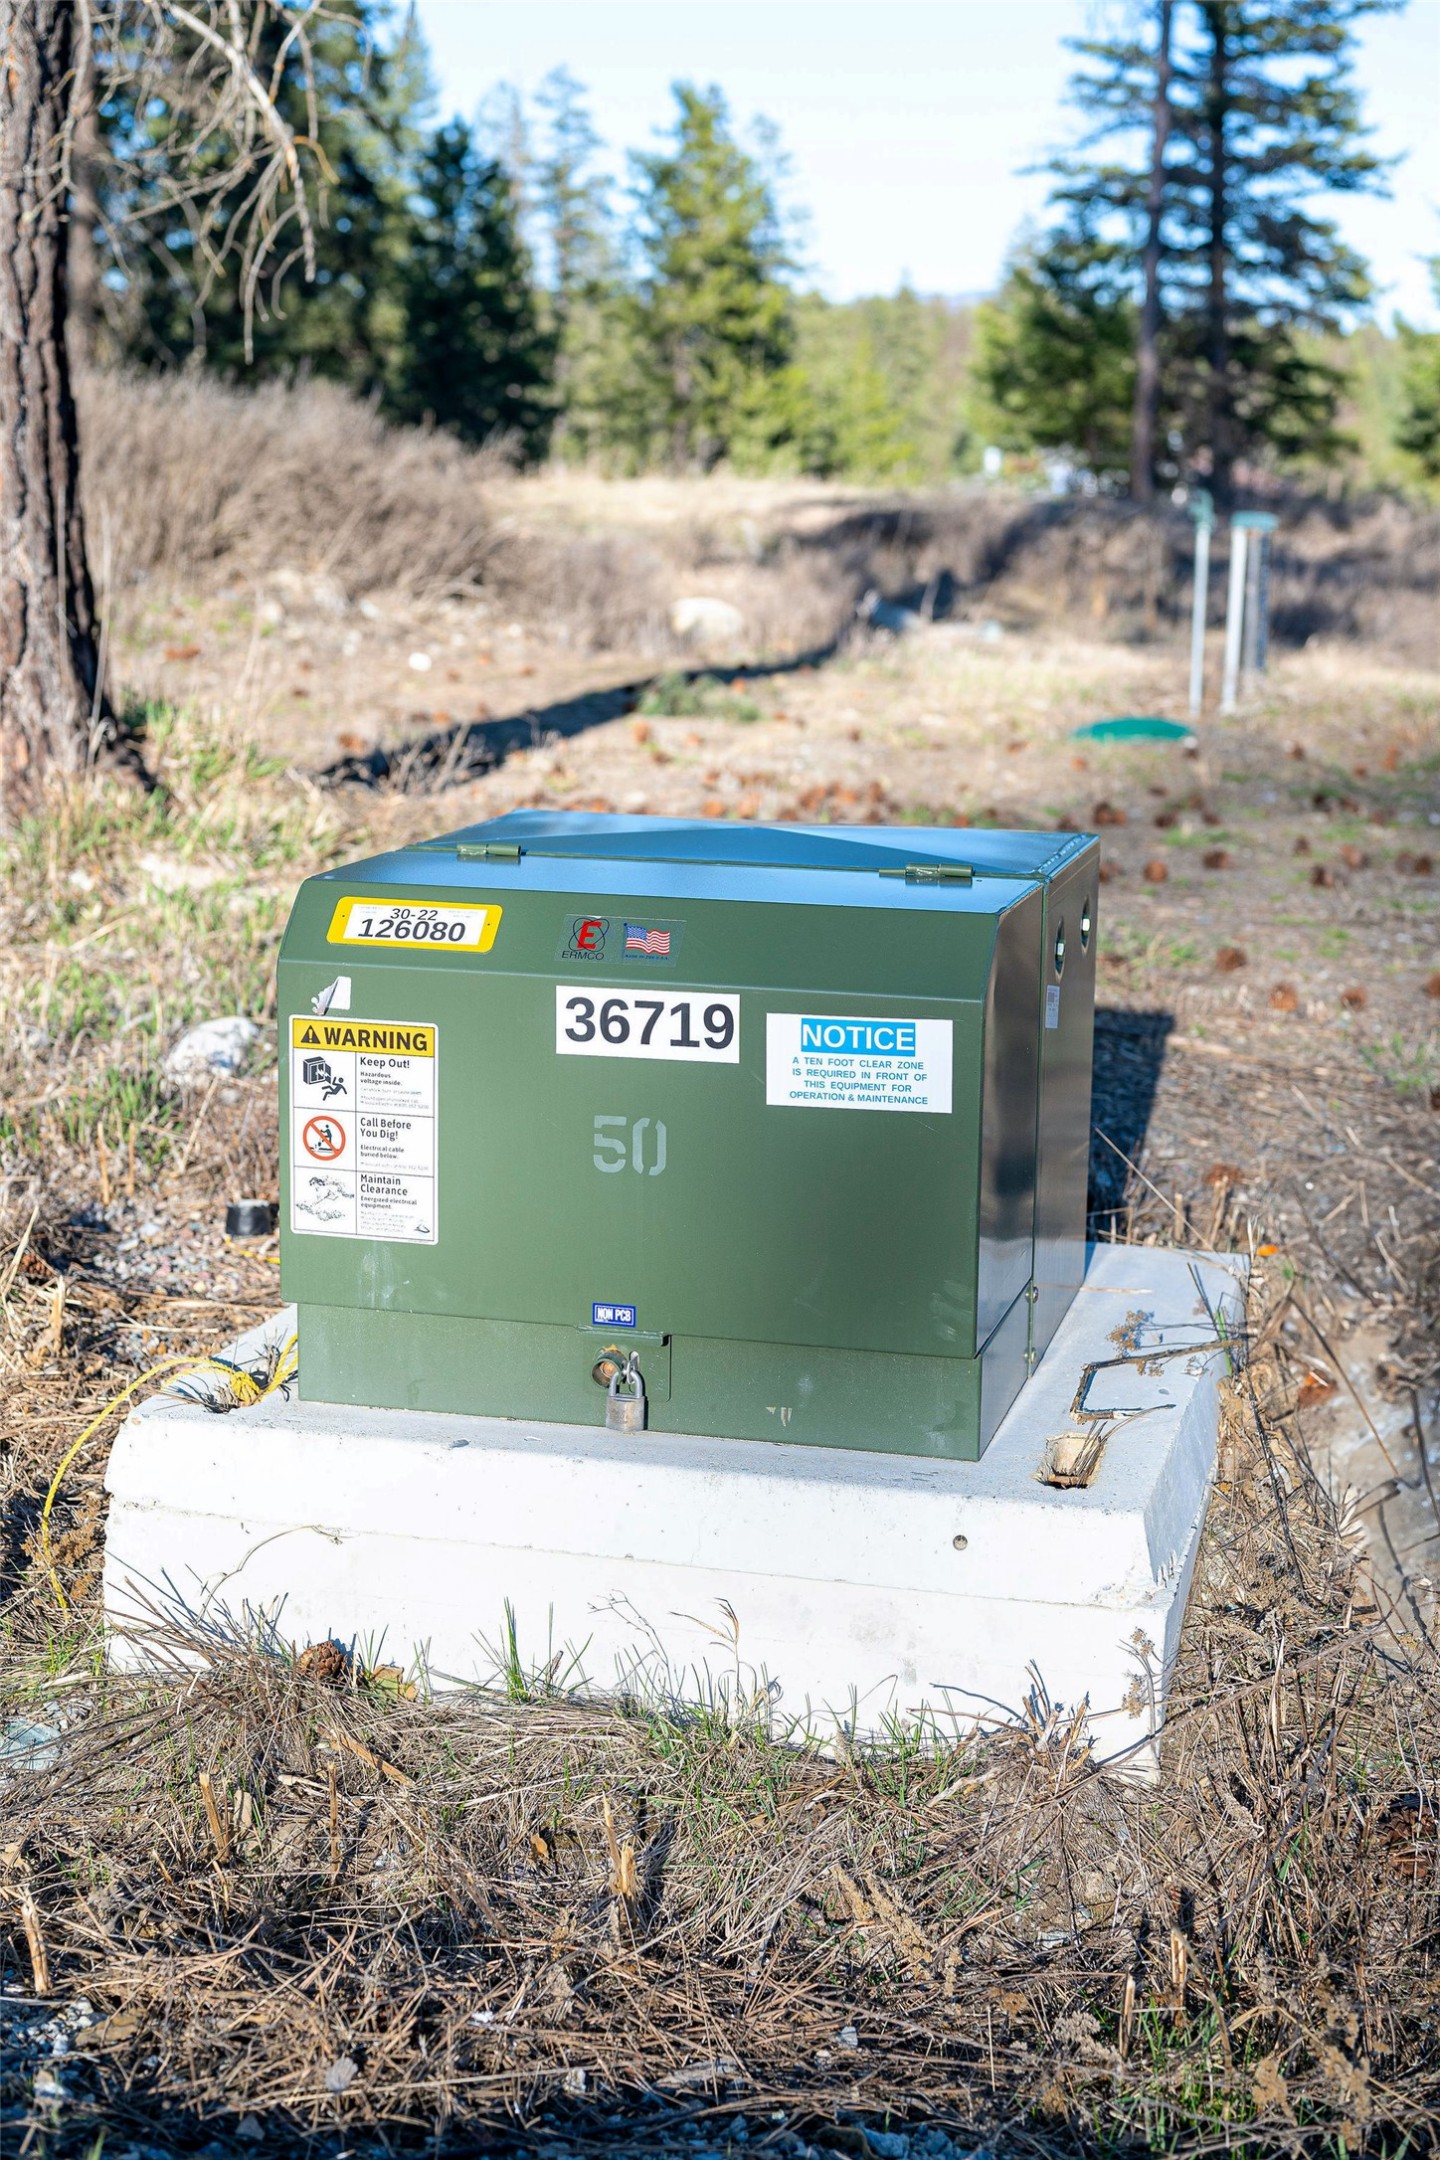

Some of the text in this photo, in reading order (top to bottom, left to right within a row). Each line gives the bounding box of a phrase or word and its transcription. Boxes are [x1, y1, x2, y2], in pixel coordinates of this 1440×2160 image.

[390, 908, 438, 921] 30-22
[358, 918, 466, 942] 126080
[577, 920, 602, 950] E
[561, 950, 605, 961] ERMCO
[564, 996, 735, 1050] 36719
[323, 1027, 428, 1052] WARNING
[802, 1023, 915, 1051] NOTICE
[360, 1056, 410, 1069] Keep Out!
[792, 1056, 924, 1070] A TEN FOOT CLEAR ZONE
[792, 1068, 928, 1082] IS REQUIRED IN FRONT OF
[804, 1080, 912, 1093] THIS EQUIPMENT FOR
[789, 1091, 929, 1105] OPERATION & MAINTENANCE
[360, 1117, 412, 1130] Call Before
[360, 1128, 399, 1142] You Dig!
[360, 1144, 388, 1152] Electrical
[593, 1115, 667, 1176] 50
[360, 1173, 402, 1186] Maintain
[360, 1183, 409, 1196] Clearance
[360, 1195, 389, 1203] Energized
[597, 1307, 631, 1321] NON PCB
